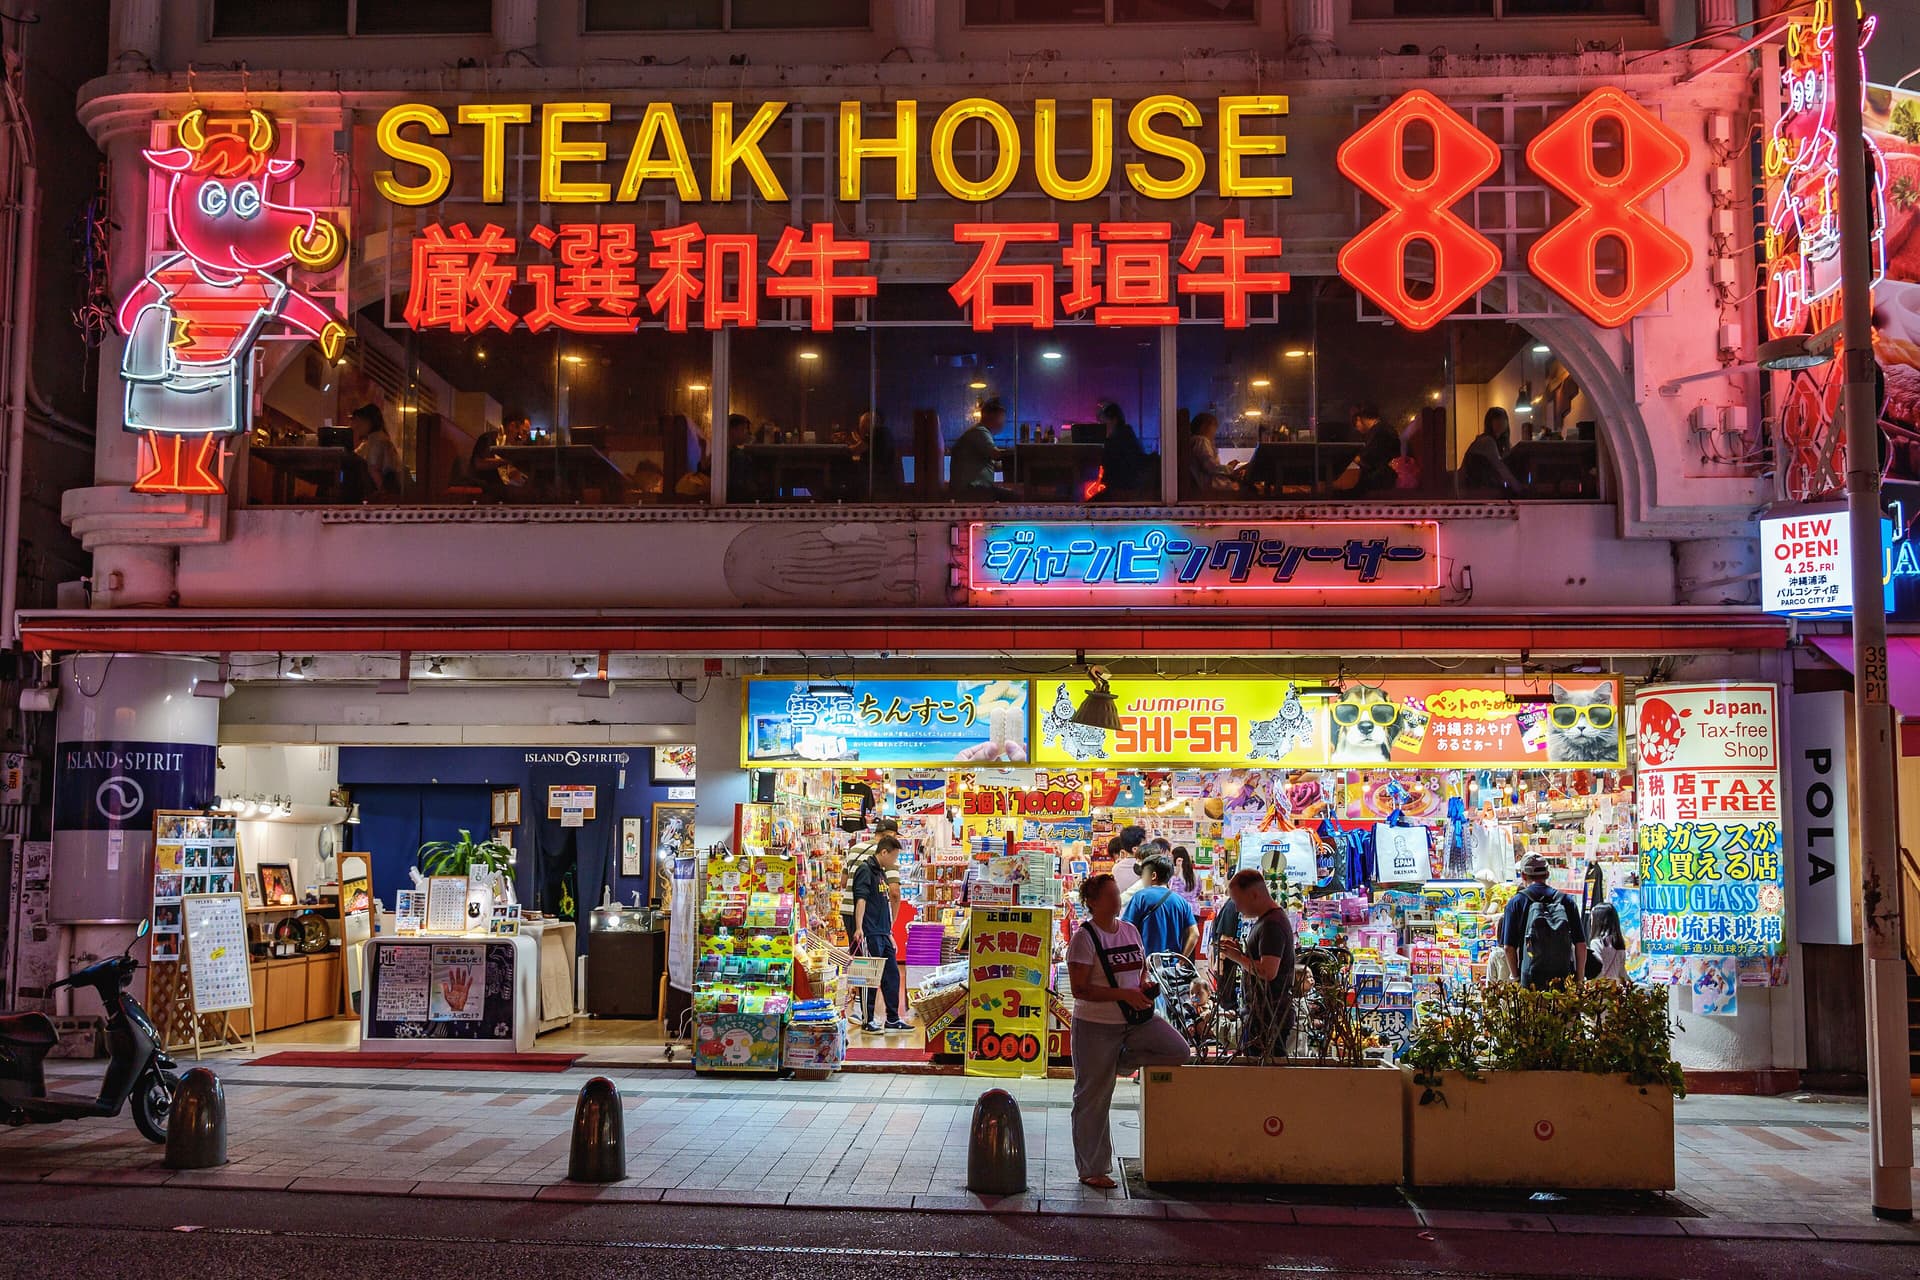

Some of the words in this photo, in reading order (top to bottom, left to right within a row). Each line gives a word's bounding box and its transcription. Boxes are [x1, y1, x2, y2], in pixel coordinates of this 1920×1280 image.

[373, 99, 789, 206] STEAK
[837, 94, 1293, 203] HOUSE
[1337, 86, 1693, 333] 88
[403, 221, 878, 334] 厳選和牛
[948, 218, 1292, 332] 石垣牛
[1782, 519, 1832, 540] NEW
[984, 528, 1426, 583] ジャンピングシーサー
[1774, 539, 1839, 560] OPEN!
[1788, 575, 1828, 587] 沖縄浦添
[1781, 597, 1806, 606] PARCO
[1807, 597, 1825, 605] CITY
[1827, 595, 1836, 603] 2F
[786, 692, 976, 727] 雪塩ちんすこう
[1127, 698, 1226, 712] JUMPING
[1703, 699, 1767, 718] Japan.
[1115, 716, 1238, 753] SHI-SA
[1432, 722, 1512, 737] 沖縄おみやげ
[1696, 722, 1768, 738] Tax-free
[525, 753, 564, 762] ISLAND
[582, 753, 620, 763] SPIRIT
[1724, 741, 1768, 761] Shop
[1701, 779, 1775, 794] TAX
[1701, 796, 1776, 811] FREE
[1804, 748, 1836, 887] POLA
[1690, 884, 1758, 912] GLASS
